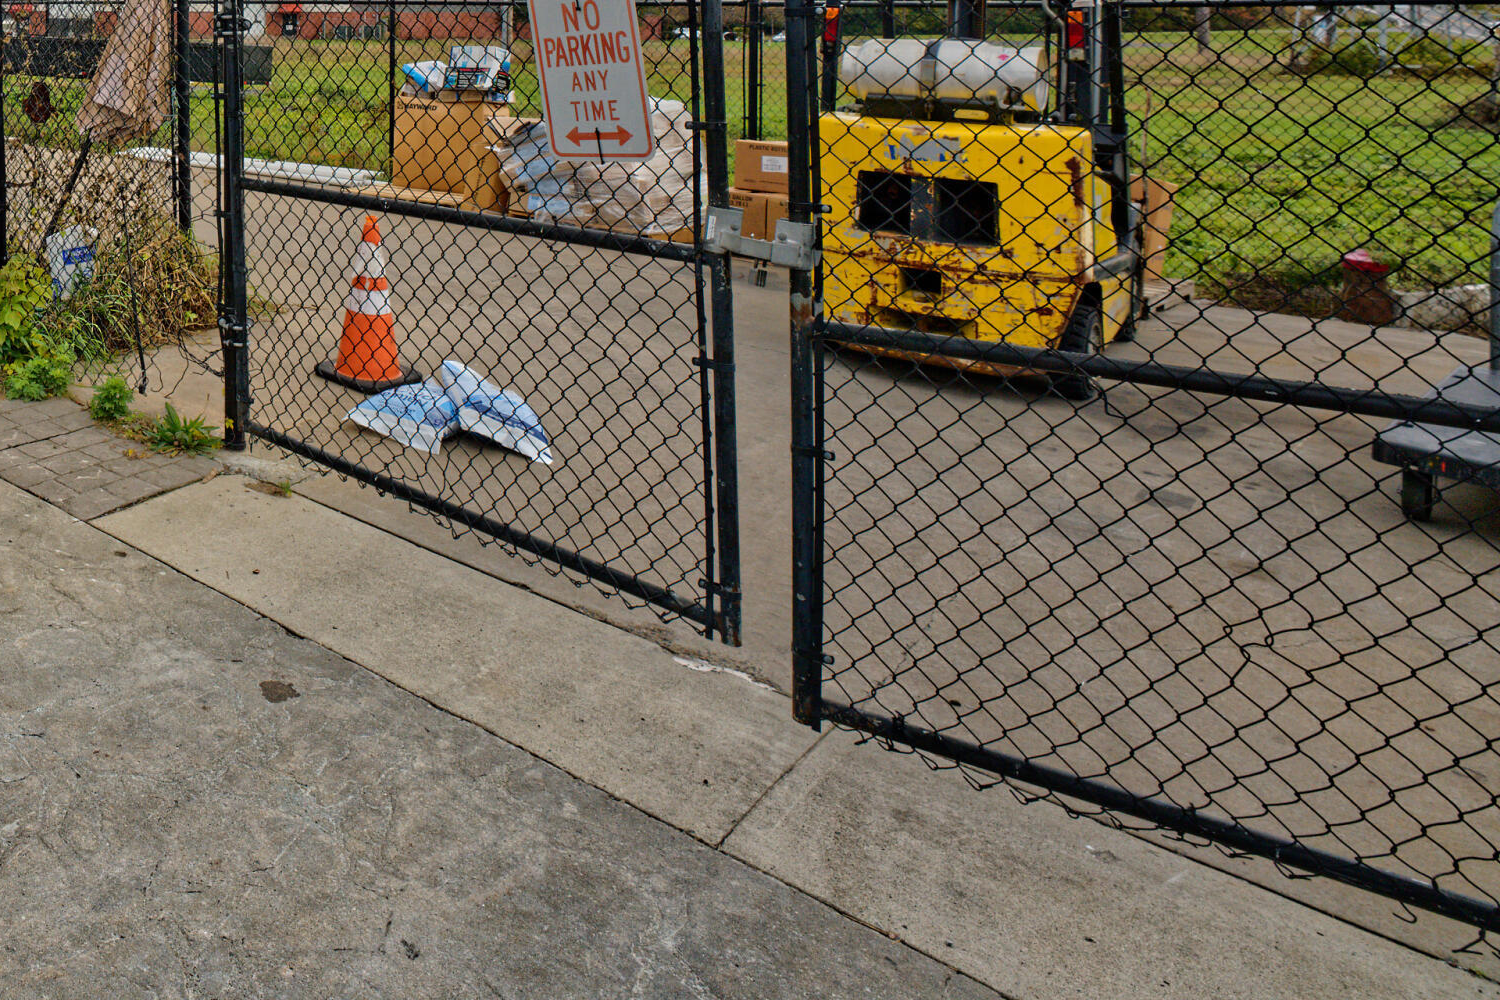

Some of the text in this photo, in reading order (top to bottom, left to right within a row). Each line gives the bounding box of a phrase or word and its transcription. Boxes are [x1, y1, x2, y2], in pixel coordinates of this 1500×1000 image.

[560, 0, 601, 33] NO
[543, 30, 631, 68] PARKING
[571, 69, 609, 92] ANY
[569, 99, 621, 122] TIME
